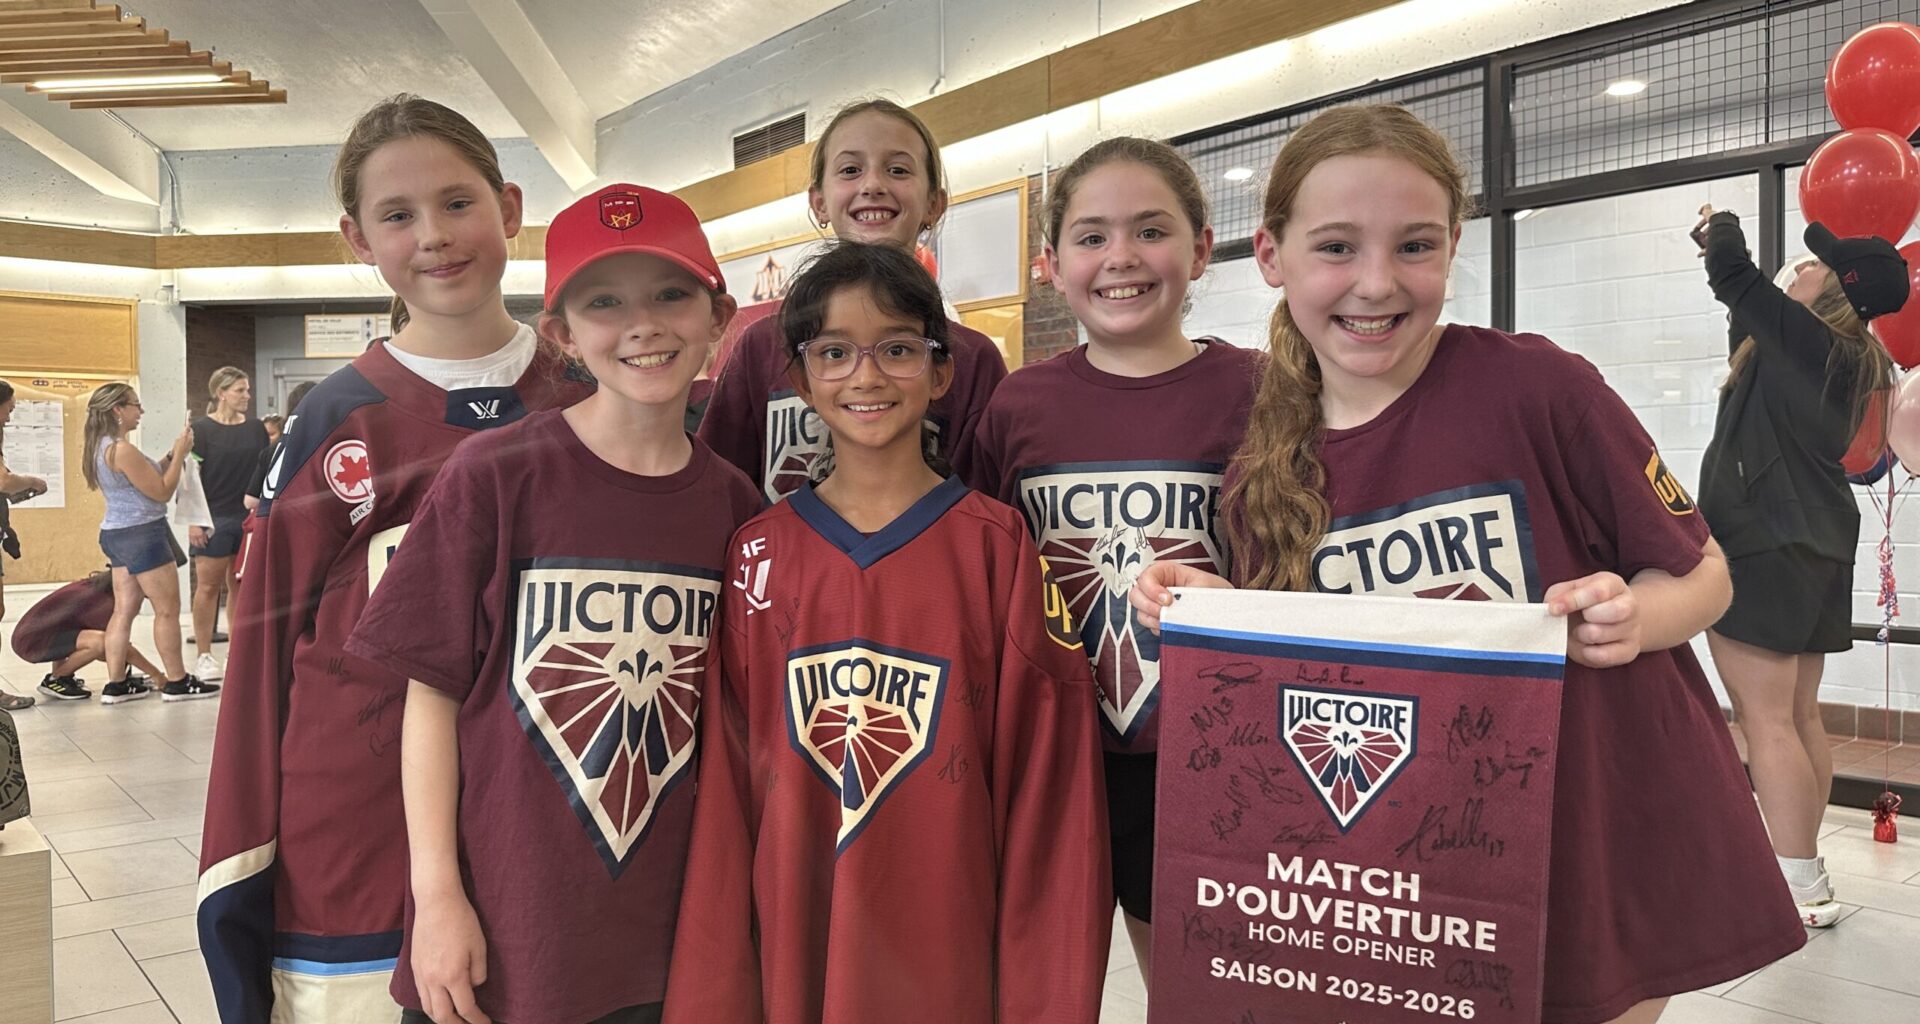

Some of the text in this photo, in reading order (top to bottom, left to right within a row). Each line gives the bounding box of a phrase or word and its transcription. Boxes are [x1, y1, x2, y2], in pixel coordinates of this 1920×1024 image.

[351, 508, 366, 521] AIR
[1311, 510, 1514, 598] CTOIRE
[523, 582, 720, 665] VICTOIR
[1289, 694, 1407, 745] VICTOIRE
[1267, 852, 1420, 902] MATCH
[1197, 877, 1497, 952] D’OUVERTURE
[1248, 921, 1325, 950] HOME
[1332, 935, 1436, 968] OPENER
[1210, 957, 1317, 992] SAISON
[1326, 976, 1476, 1019] 2025-2026
